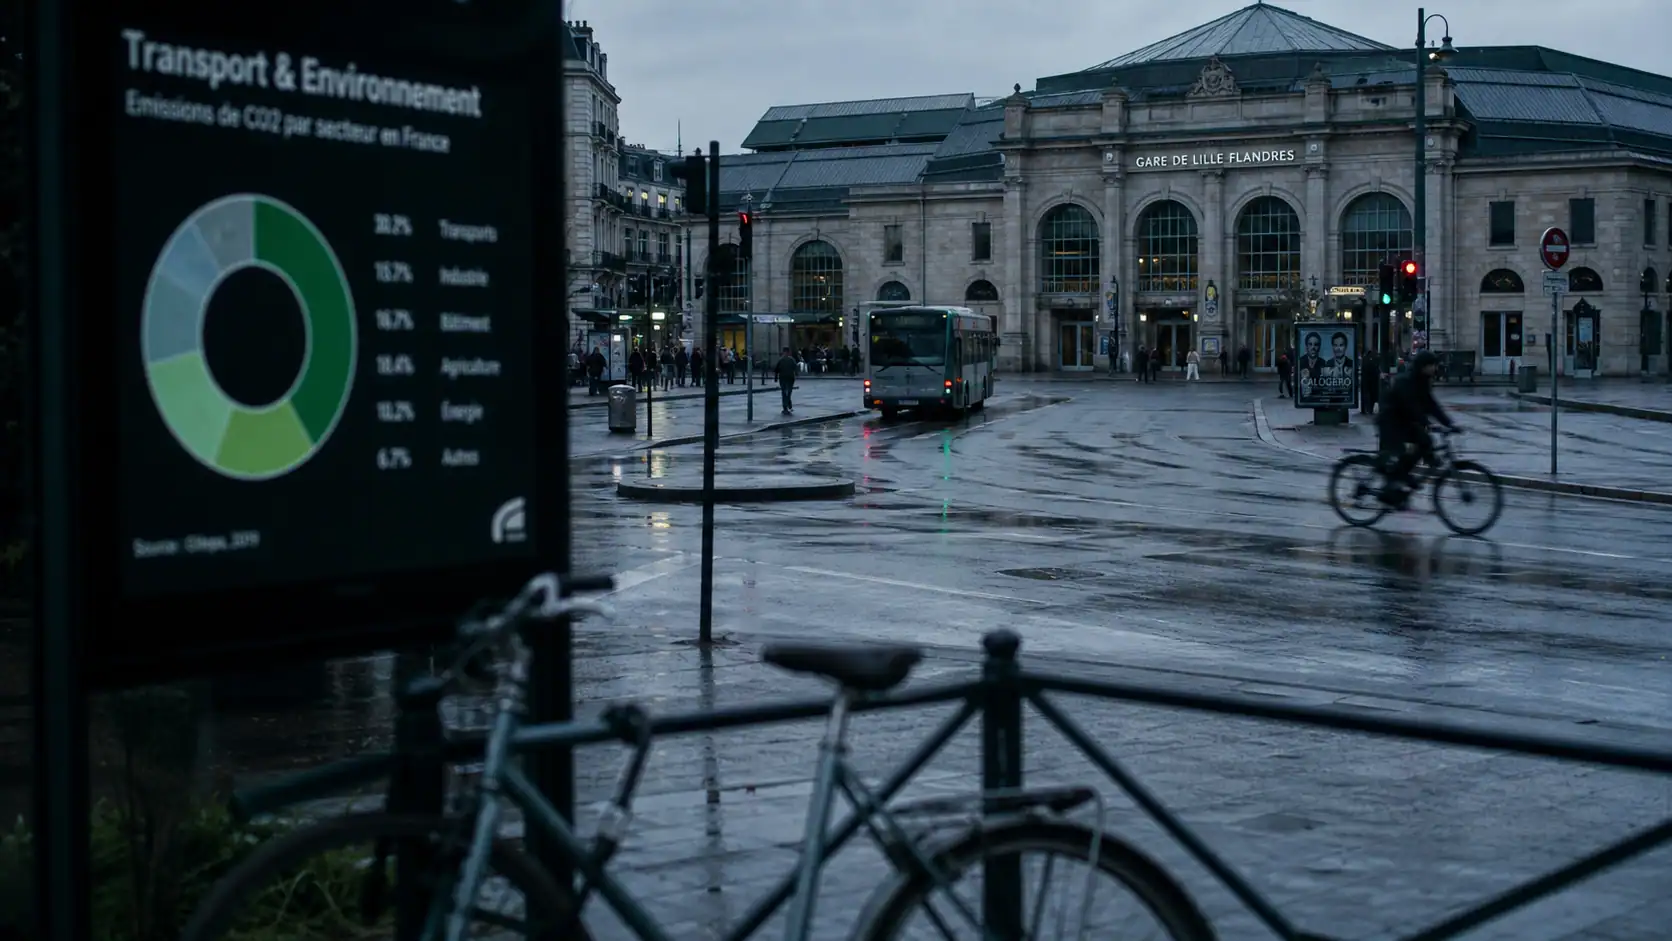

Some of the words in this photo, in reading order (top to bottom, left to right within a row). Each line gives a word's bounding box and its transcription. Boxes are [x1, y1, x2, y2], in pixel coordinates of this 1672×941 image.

[121, 28, 267, 90] Transport
[273, 52, 297, 91] &
[301, 56, 481, 118] Environnement
[217, 102, 241, 128] de
[243, 105, 282, 134] CO2
[283, 113, 312, 138] par
[314, 118, 378, 144] secteur
[380, 127, 400, 146] en
[401, 125, 450, 153] France
[1136, 156, 1167, 168] GARE
[1172, 154, 1188, 166] DE
[1193, 153, 1224, 165] LILLE
[1229, 149, 1295, 163] FLANDRES
